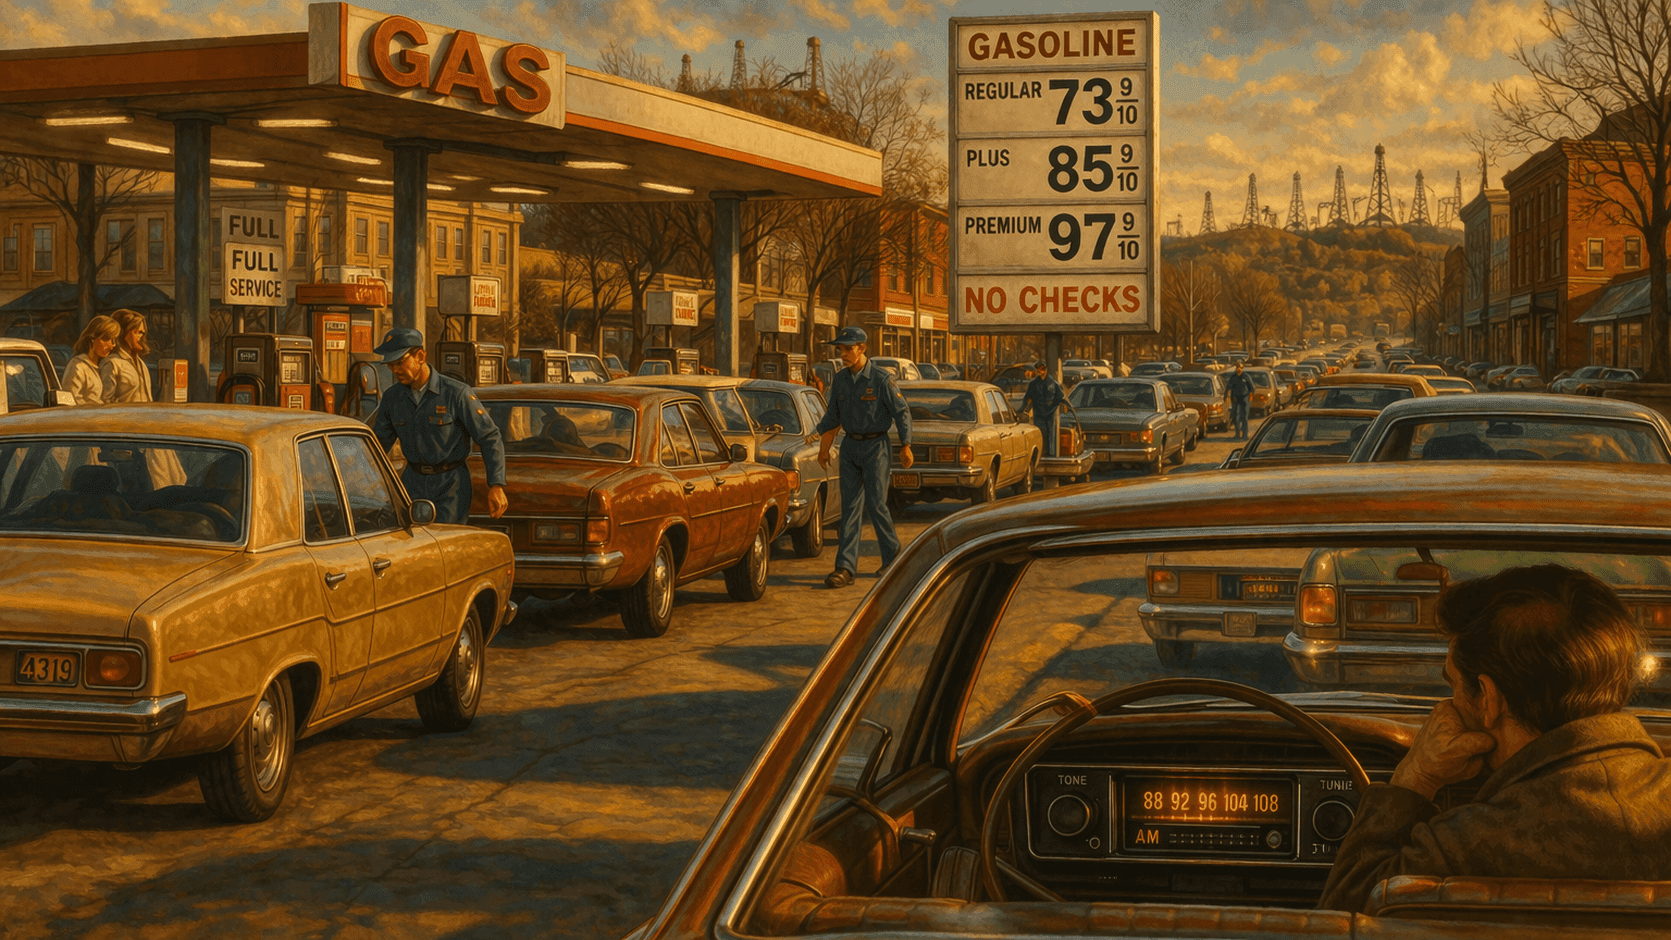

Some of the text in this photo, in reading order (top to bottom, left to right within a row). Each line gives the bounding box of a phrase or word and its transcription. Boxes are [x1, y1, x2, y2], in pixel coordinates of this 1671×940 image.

[968, 28, 1136, 61] GASOLINE
[368, 15, 551, 114] GAS
[965, 81, 1042, 100] REGULAR
[1049, 77, 1113, 125] 73
[967, 149, 1010, 167] PLUS
[1048, 145, 1114, 193] 85
[228, 214, 280, 239] FULL
[965, 216, 1042, 234] PREMIUM
[1048, 213, 1116, 261] 97
[232, 249, 279, 272] FULL
[230, 278, 282, 298] SERVICE
[965, 285, 1140, 314] NO CHECKS
[20, 656, 72, 682] 4319
[1058, 775, 1087, 786] TONE
[1143, 791, 1279, 813] 88 92 96 104 108
[1135, 829, 1160, 844] AM
